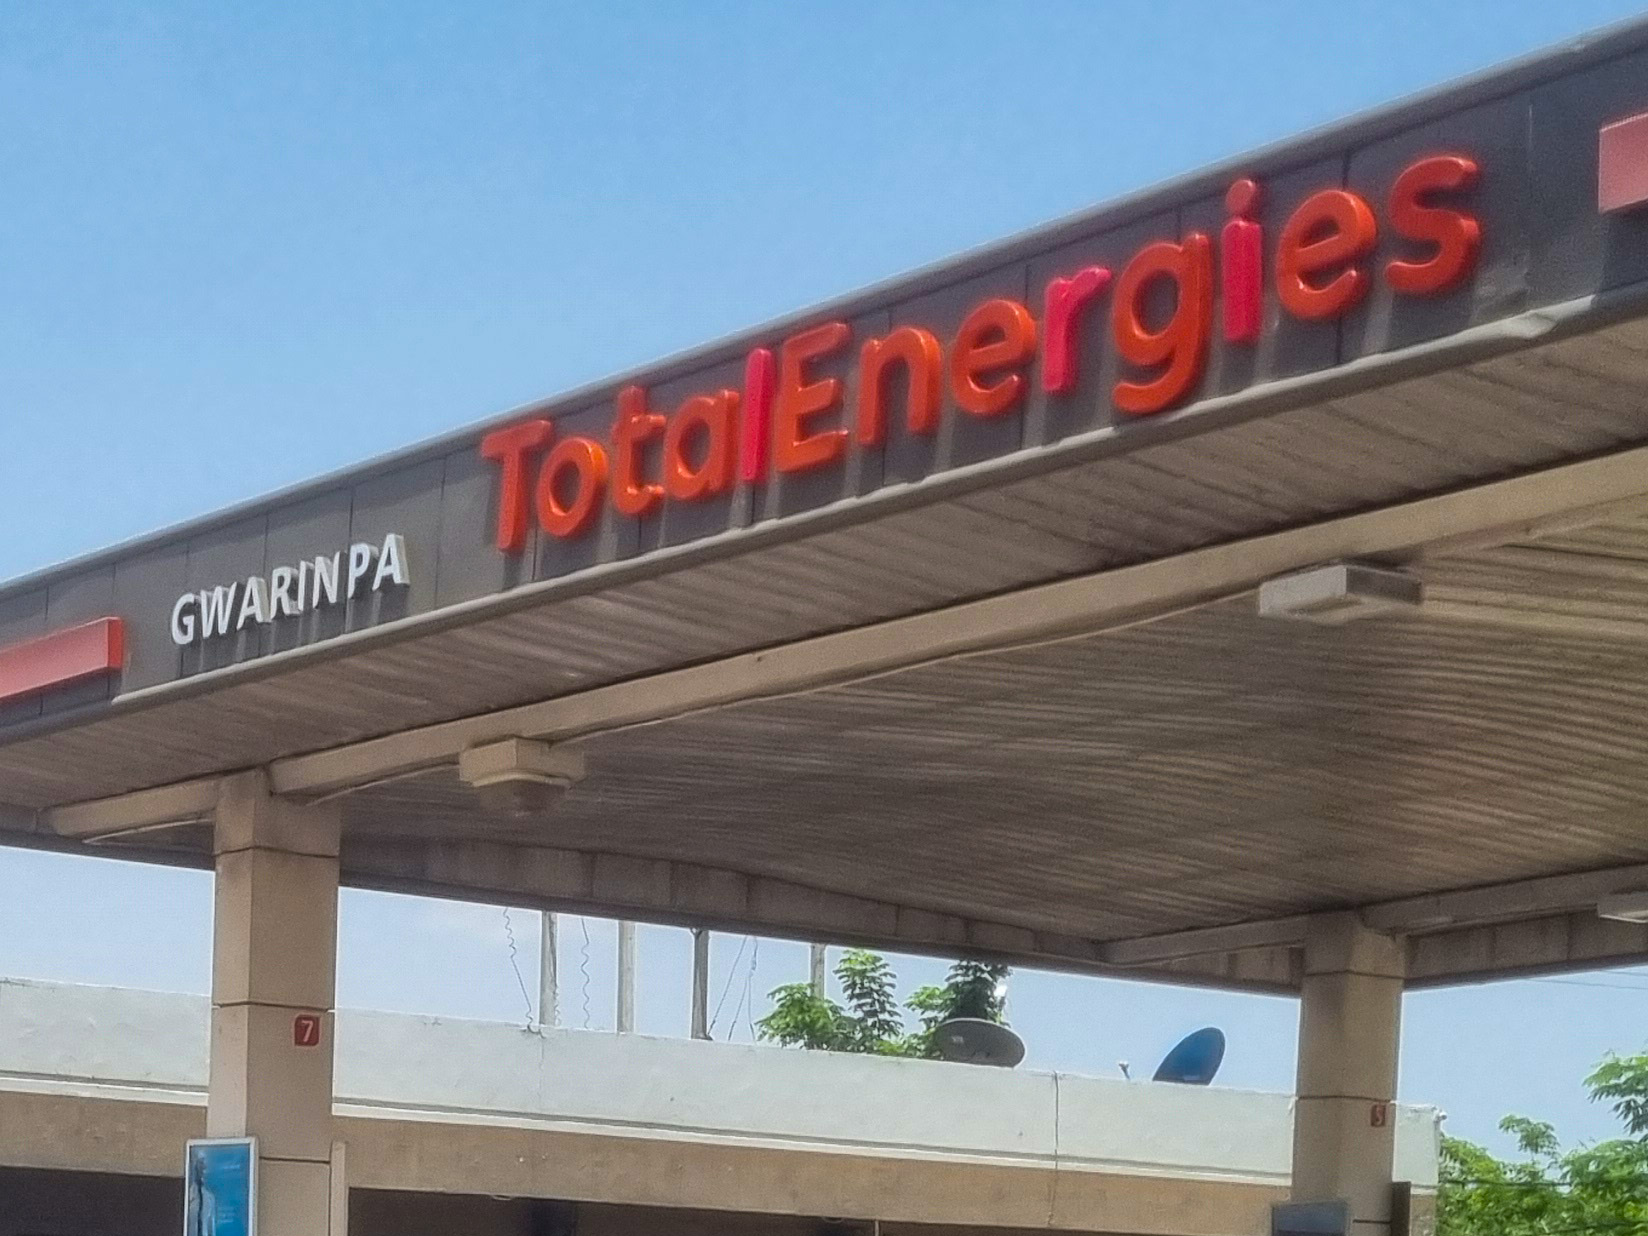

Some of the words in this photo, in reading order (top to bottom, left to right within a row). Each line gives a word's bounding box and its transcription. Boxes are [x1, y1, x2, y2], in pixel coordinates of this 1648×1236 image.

[480, 152, 1482, 553] TotalEnergies
[171, 533, 410, 645] GWARINPA
[302, 1019, 314, 1043] 7
